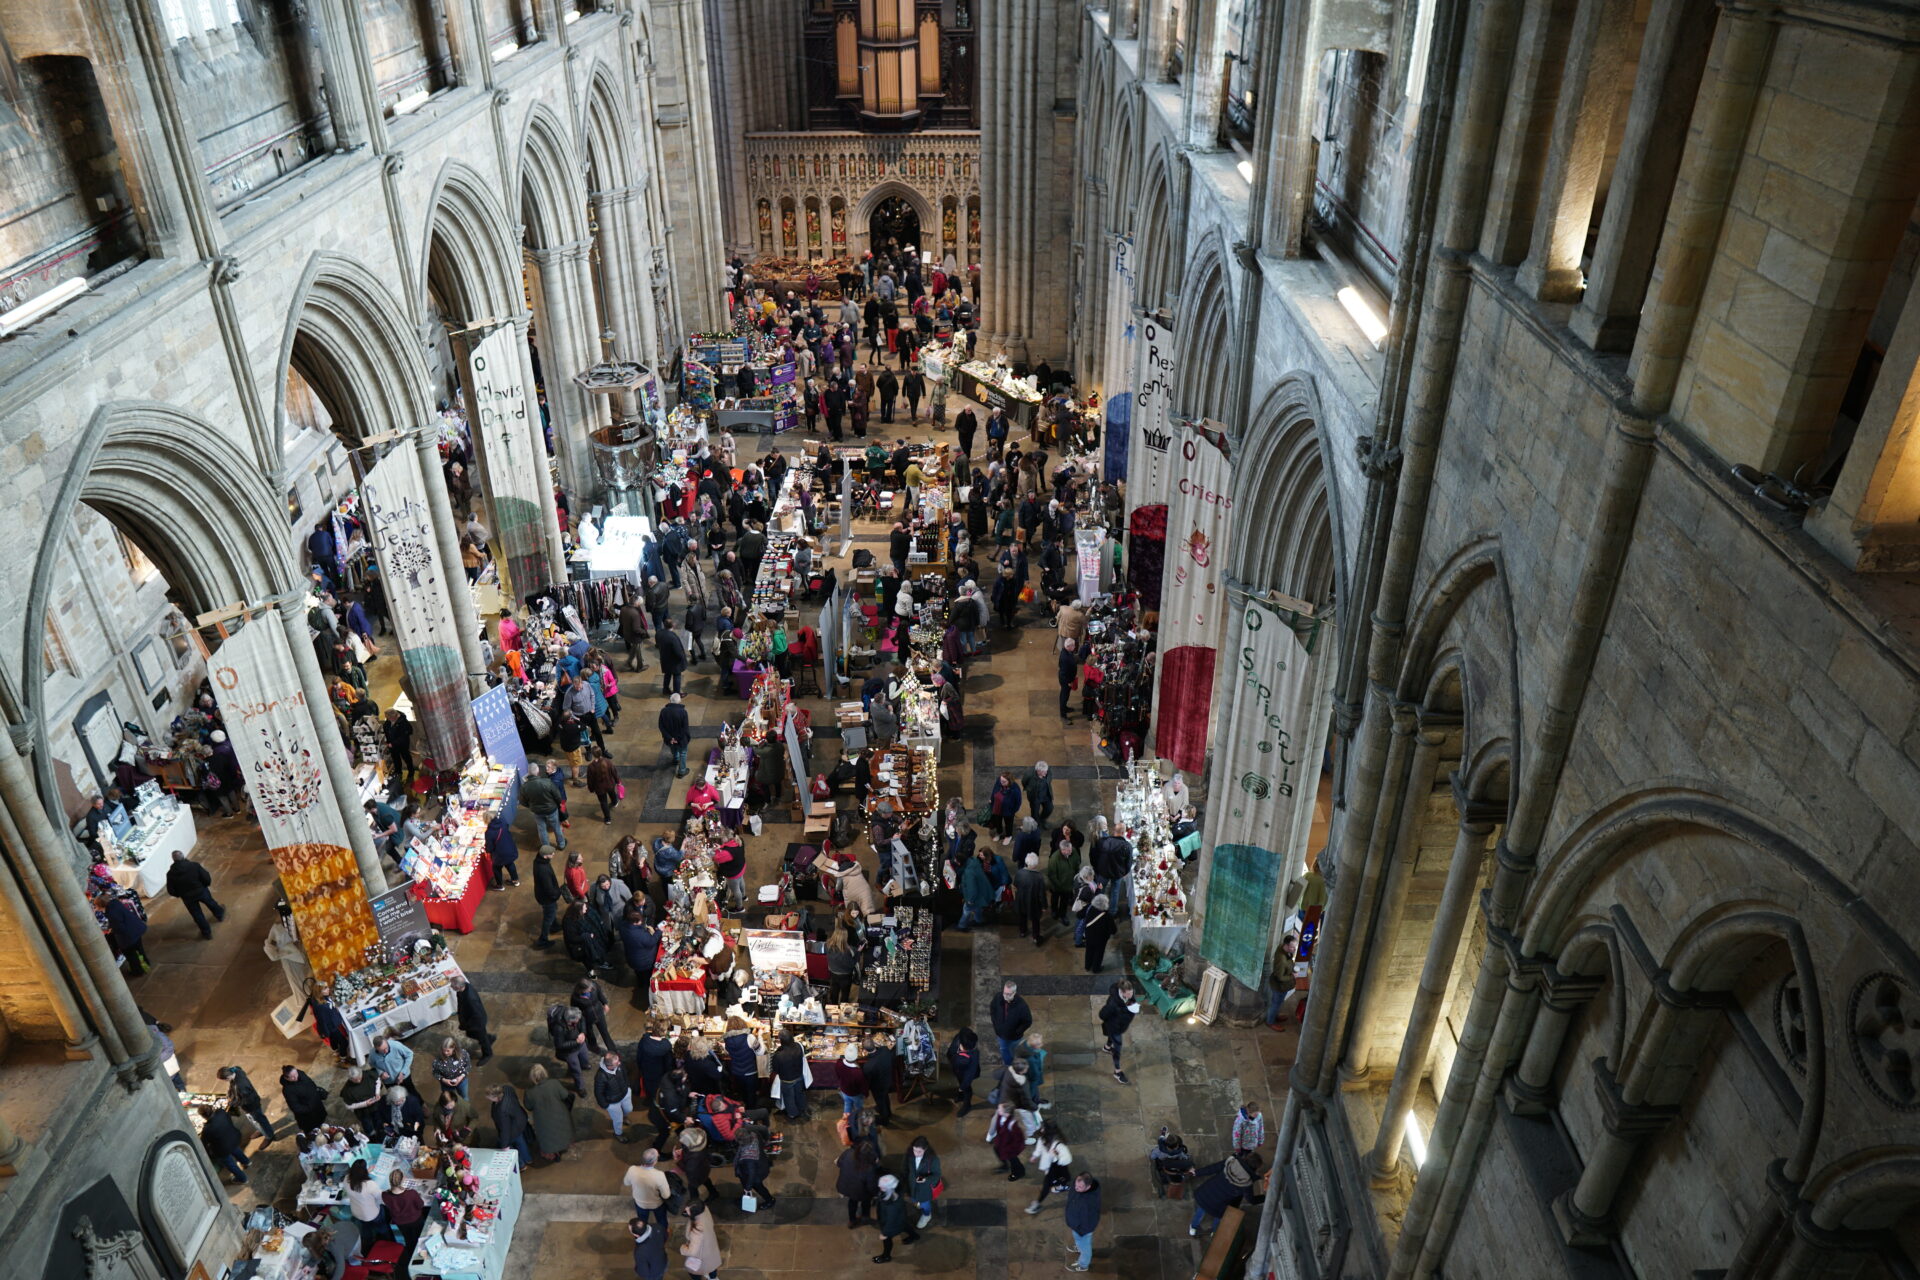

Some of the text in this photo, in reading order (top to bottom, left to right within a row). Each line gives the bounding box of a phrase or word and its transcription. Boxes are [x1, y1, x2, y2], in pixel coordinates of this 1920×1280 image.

[1145, 324, 1156, 341] O
[474, 356, 486, 371] O
[1183, 440, 1196, 461] O
[1246, 608, 1263, 632] O
[215, 666, 239, 691] O
[377, 907, 395, 917] Come
[383, 914, 400, 926] won't
[390, 910, 401, 918] me
